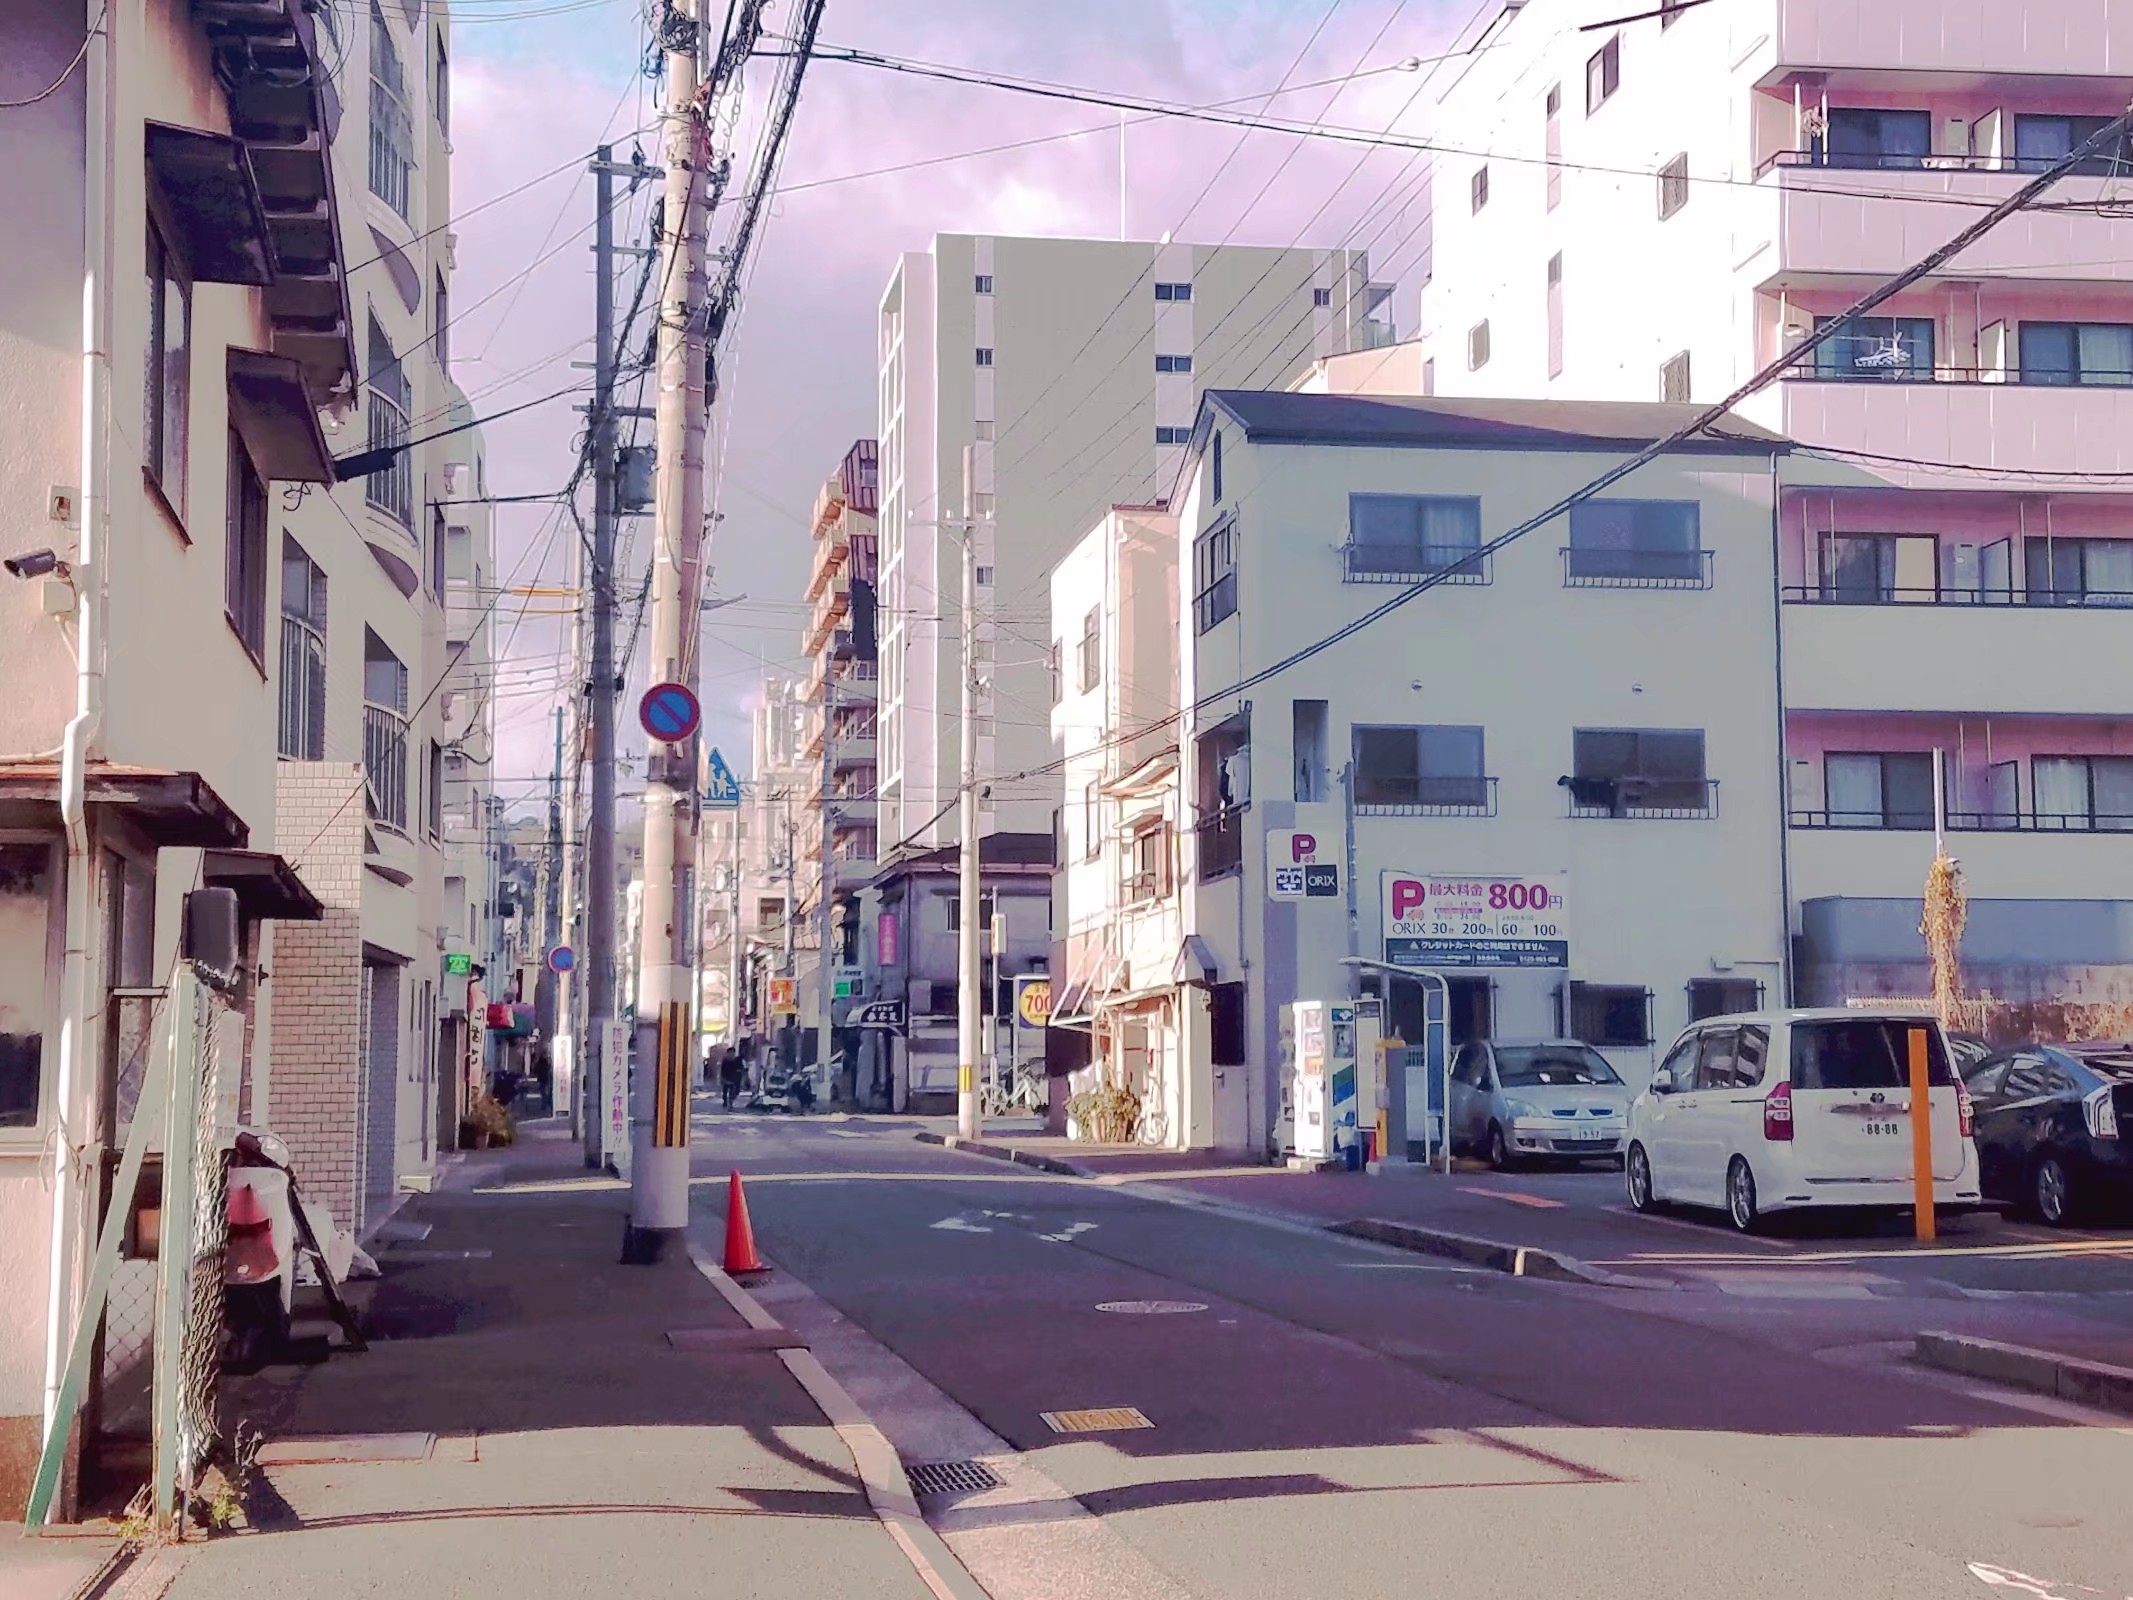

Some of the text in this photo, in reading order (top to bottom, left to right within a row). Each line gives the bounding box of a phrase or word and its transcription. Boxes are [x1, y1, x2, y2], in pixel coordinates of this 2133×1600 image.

[1292, 833, 1317, 863] P
[1308, 875, 1337, 888] ORIX
[1430, 882, 1483, 897] 最大料金
[1392, 880, 1426, 920] P
[1392, 922, 1426, 935] ORIX
